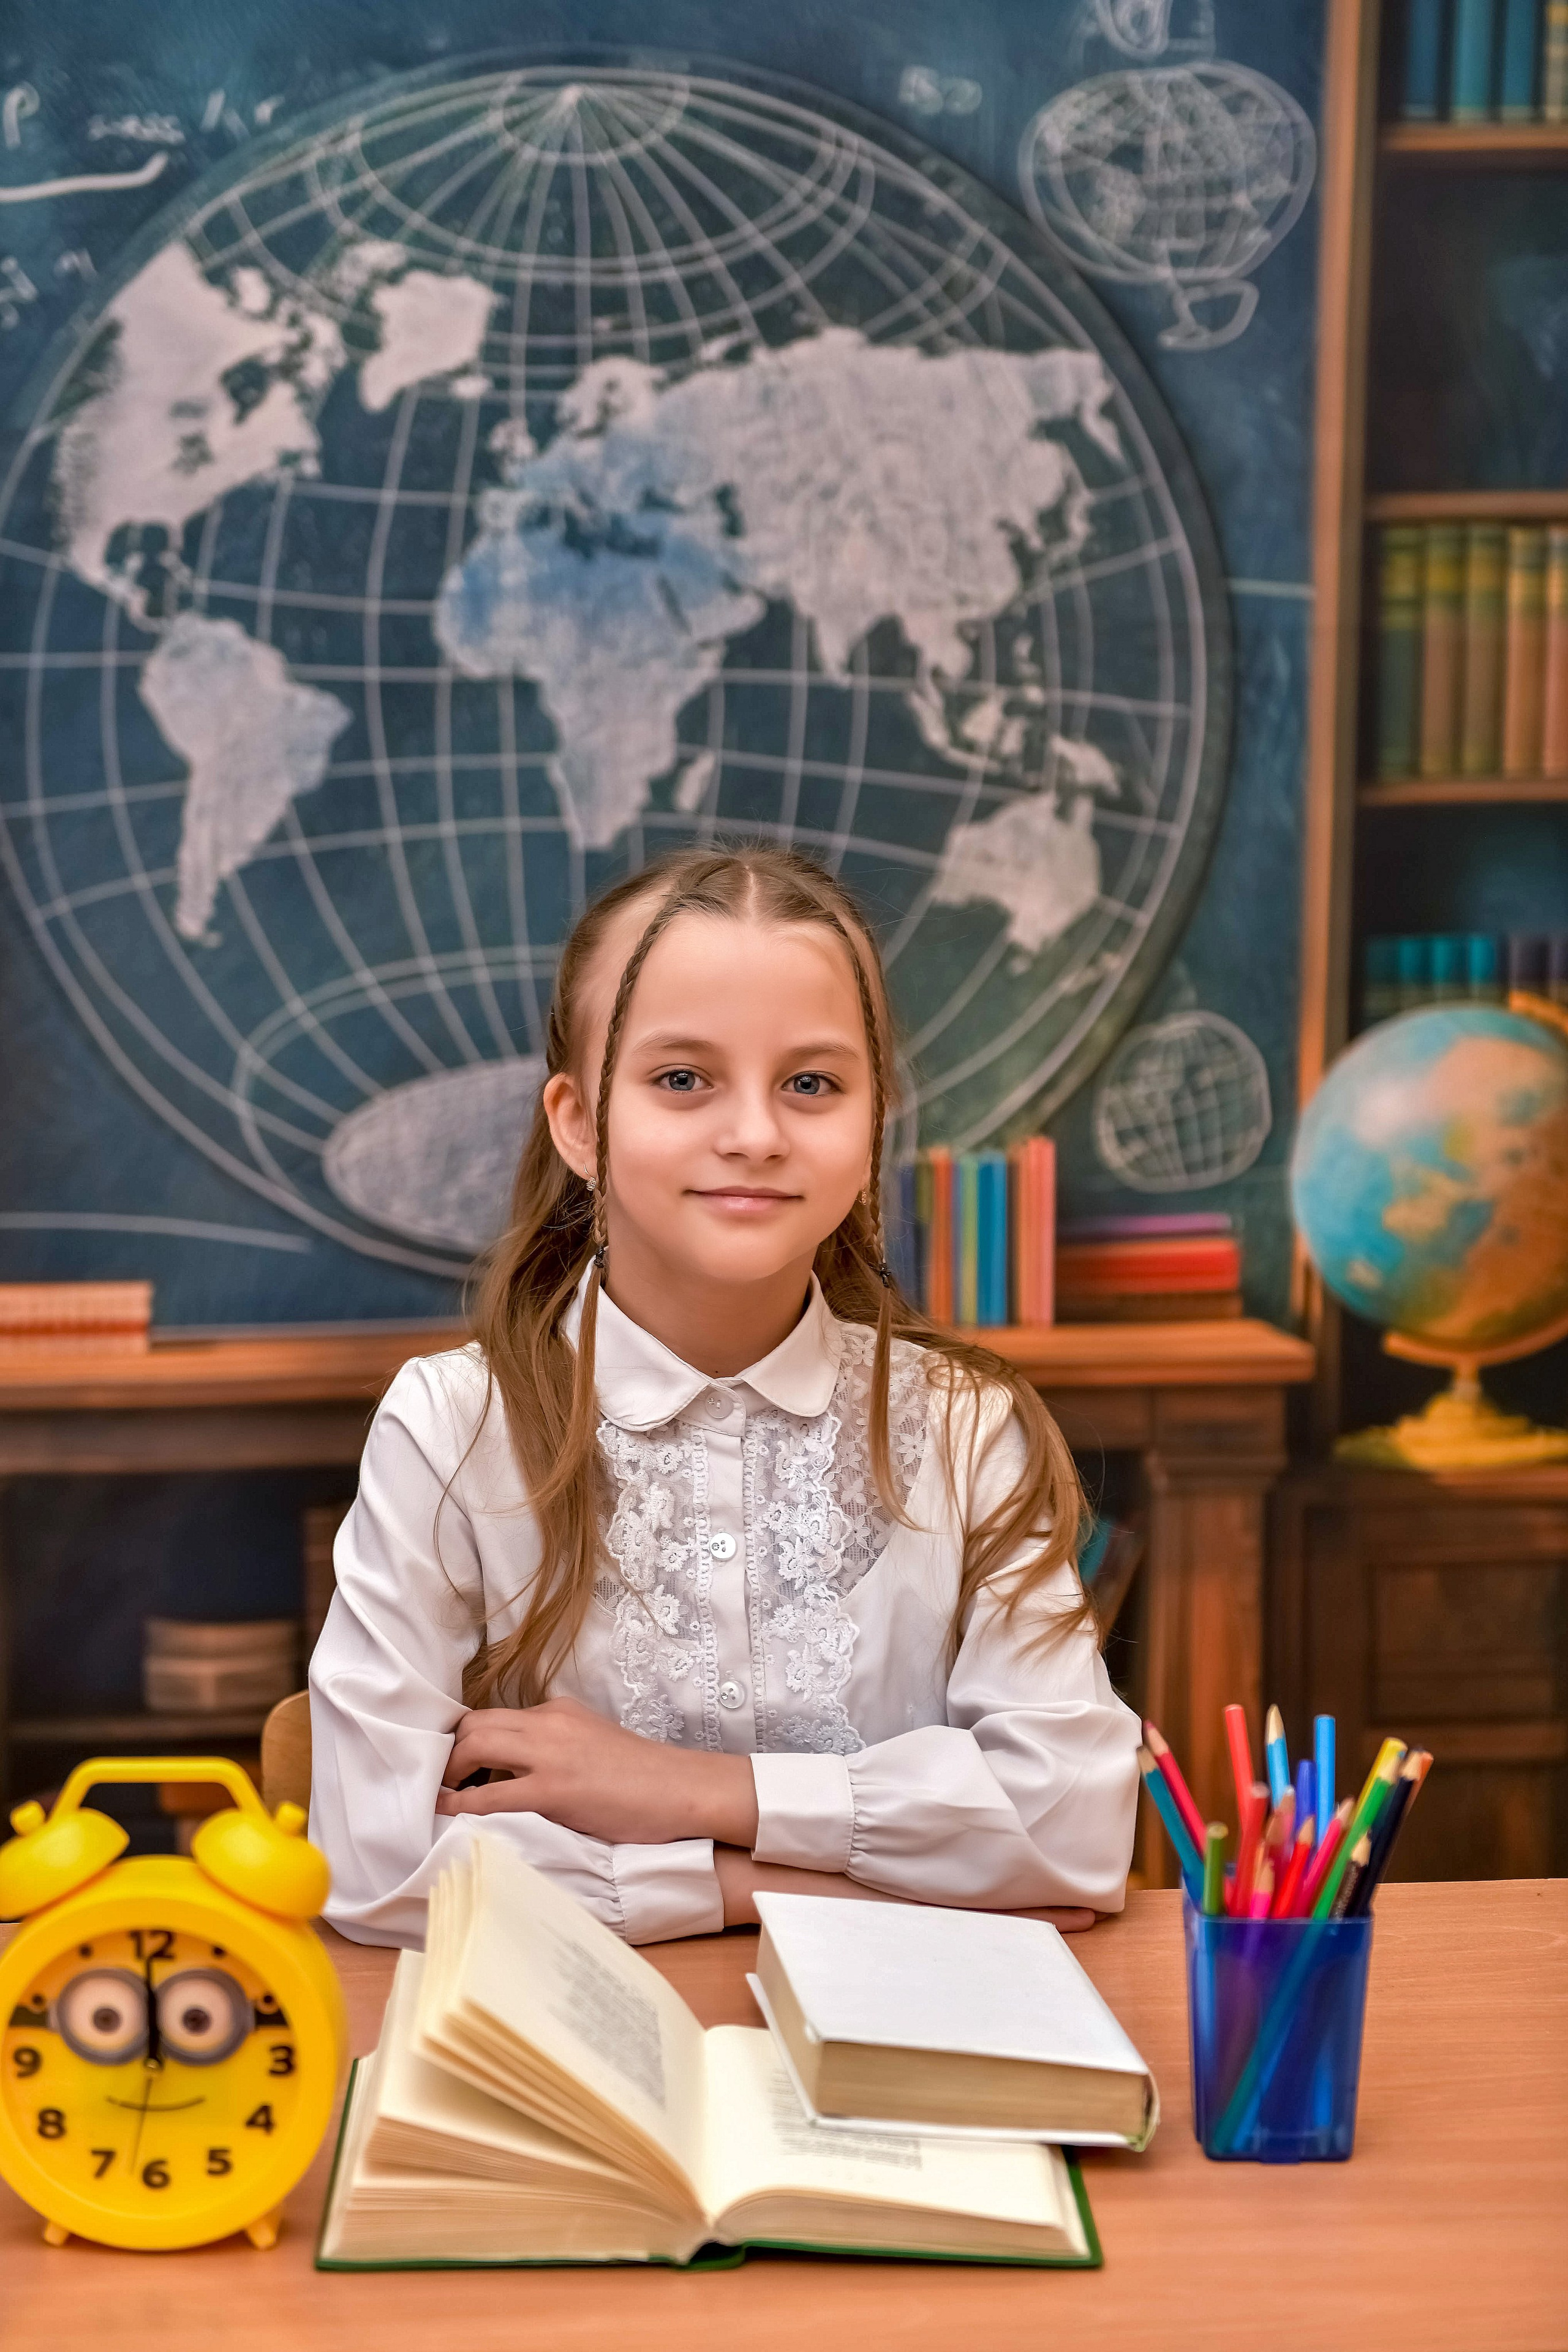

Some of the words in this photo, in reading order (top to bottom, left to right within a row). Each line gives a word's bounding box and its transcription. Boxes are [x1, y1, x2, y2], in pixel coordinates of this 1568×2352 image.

[129, 1929, 175, 1960] 12
[13, 2048, 41, 2077] 9
[270, 2045, 295, 2076] 3
[38, 2108, 65, 2138] 8
[246, 2105, 273, 2134] 4
[92, 2150, 115, 2177] 7
[143, 2160, 169, 2188] 6
[208, 2149, 231, 2175] 5
